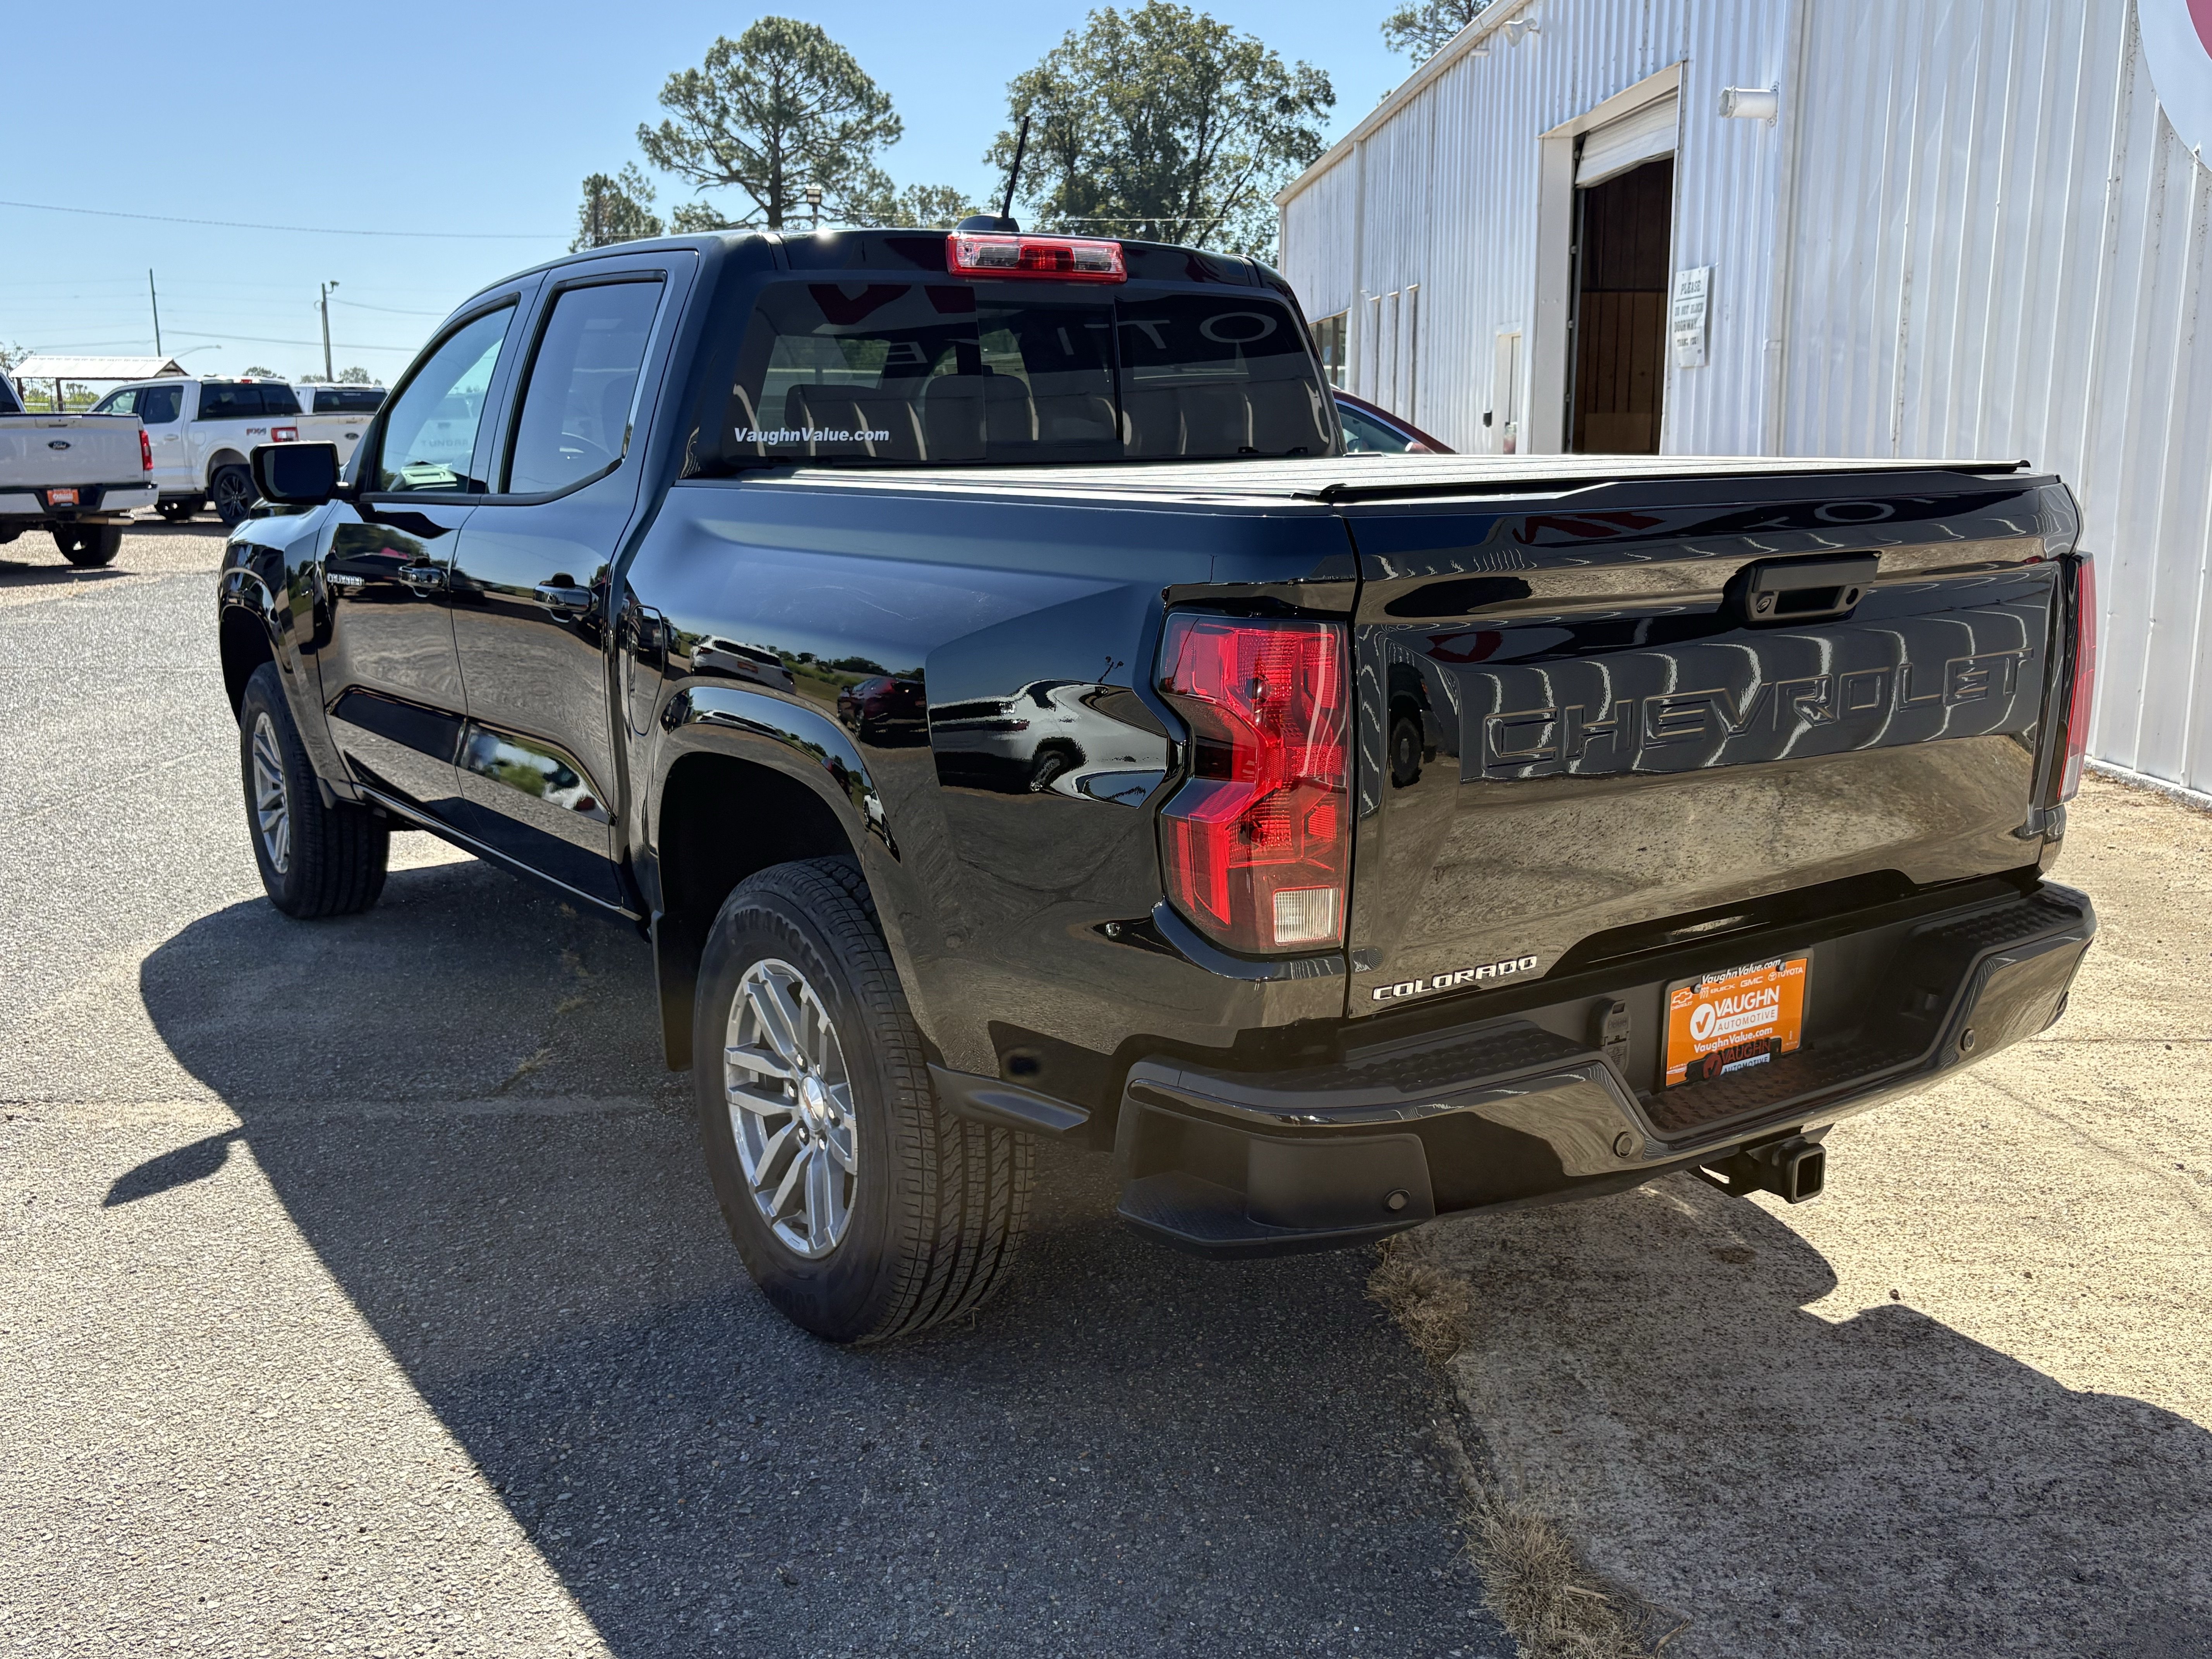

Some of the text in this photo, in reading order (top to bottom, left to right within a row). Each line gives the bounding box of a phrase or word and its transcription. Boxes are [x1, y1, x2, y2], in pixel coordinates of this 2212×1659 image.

[1680, 280, 1701, 295] PLEASE
[734, 427, 890, 445] VaughnValue.com
[1482, 647, 2034, 777] CHEVROLET
[1372, 954, 1537, 1001] COLORADO
[1702, 959, 1781, 986] VaughnValue.com
[1710, 967, 1803, 994] BUICK GMC TOYOTA
[1714, 985, 1779, 1017] VAUGHN
[1717, 1009, 1775, 1032] AUTOMOTIVE
[1694, 1027, 1772, 1053] VaughnValue.com
[1721, 1038, 1771, 1064] VAUGHN
[1723, 1056, 1769, 1073] AUTOMOTIVE
